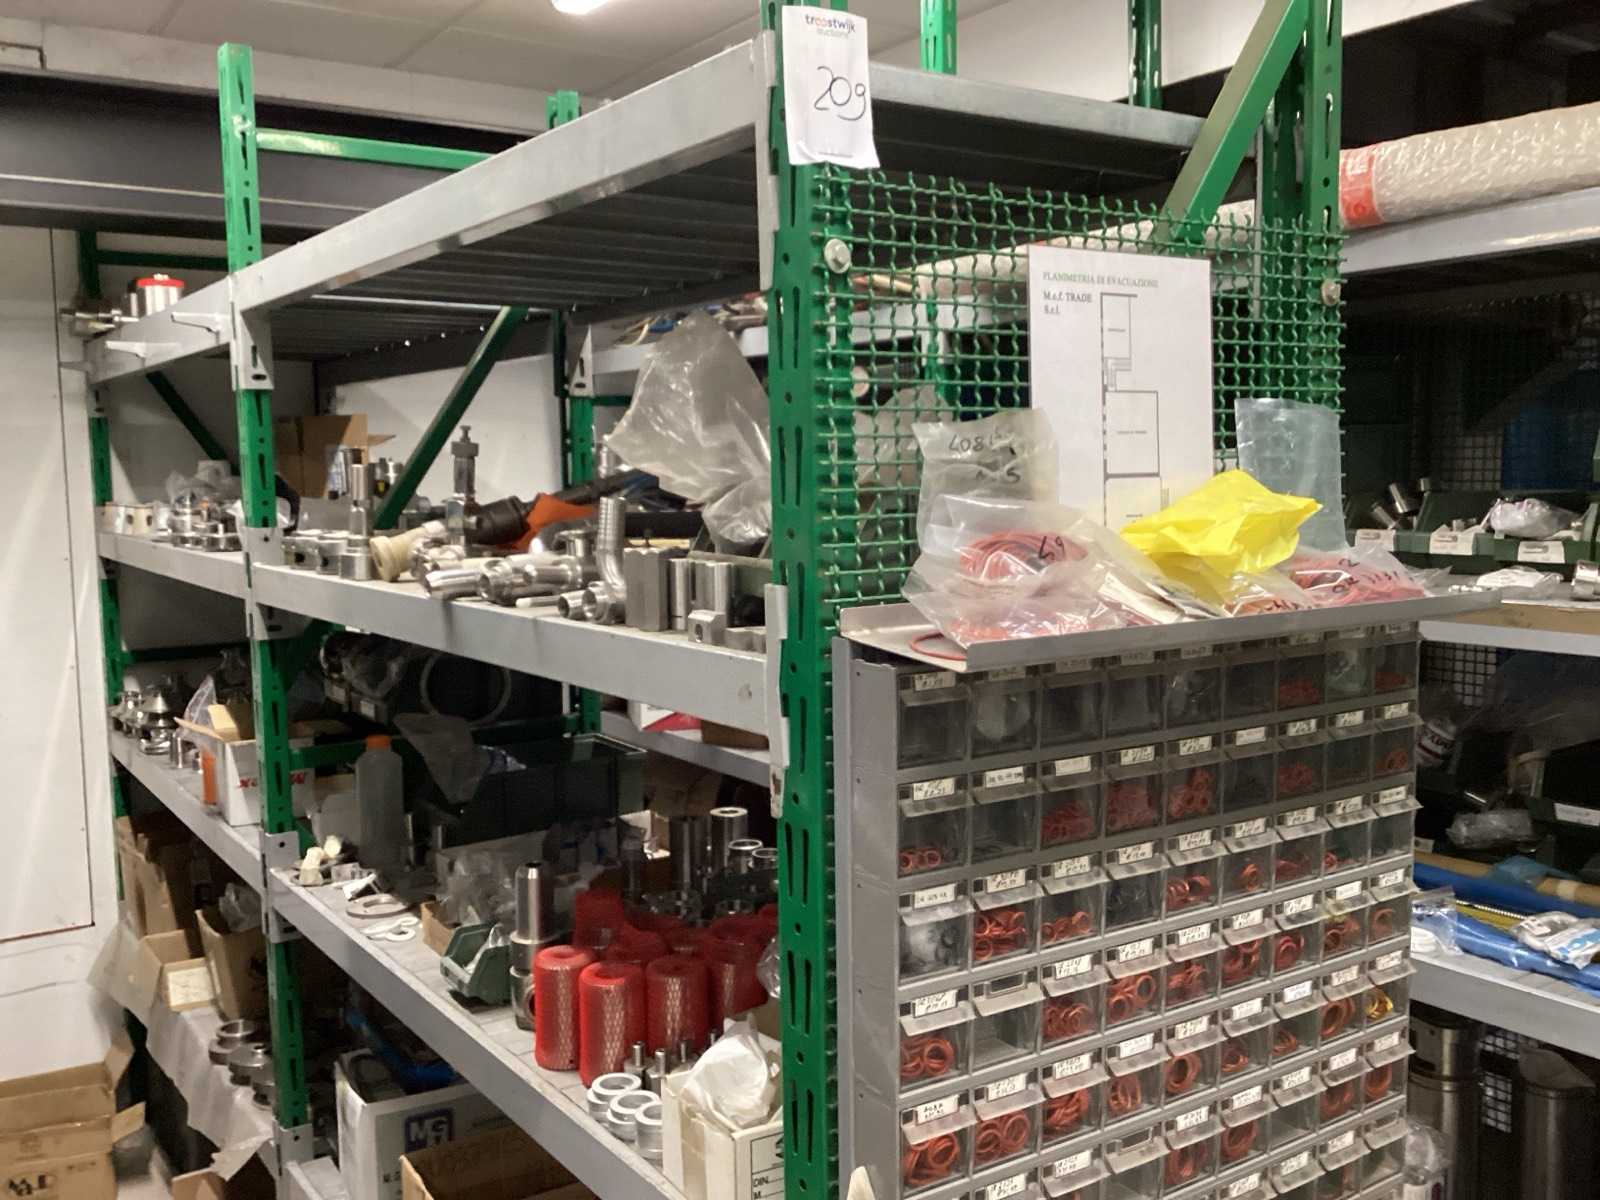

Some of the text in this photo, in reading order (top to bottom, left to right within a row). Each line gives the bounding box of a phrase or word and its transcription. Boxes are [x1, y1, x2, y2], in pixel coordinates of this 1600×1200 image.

[805, 13, 856, 34] troostwijk
[814, 65, 867, 121] 209
[1065, 292, 1093, 303] TRADE
